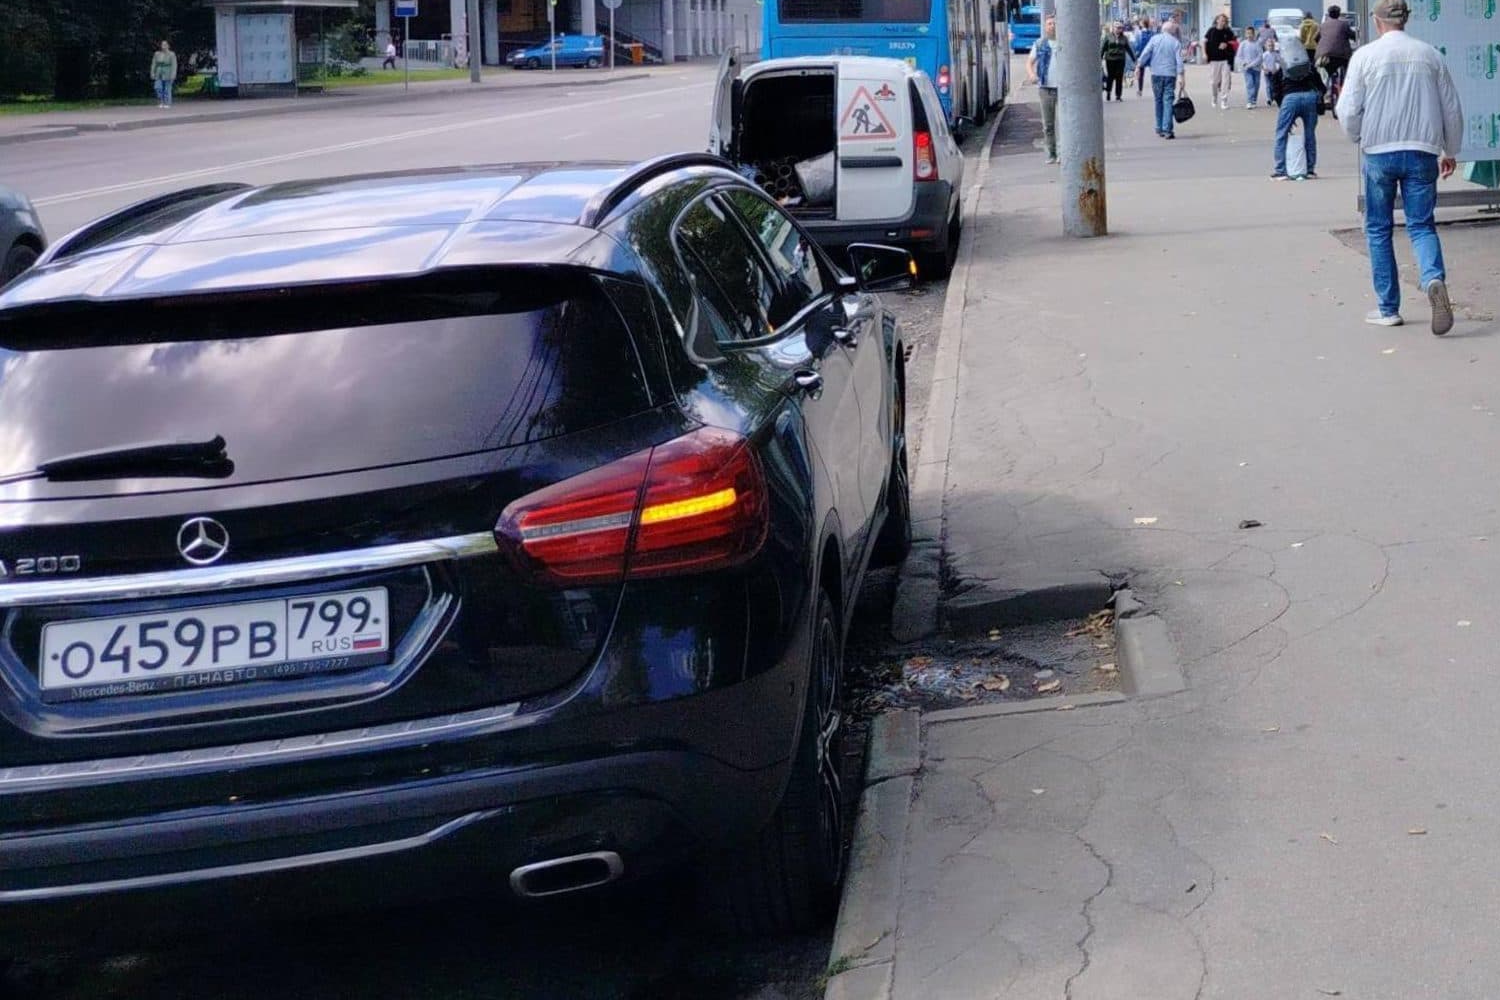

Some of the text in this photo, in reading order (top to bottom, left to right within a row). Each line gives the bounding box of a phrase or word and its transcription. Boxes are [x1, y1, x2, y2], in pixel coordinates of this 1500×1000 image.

[16, 555, 80, 575] 200
[61, 596, 372, 679] О459РВ 799
[312, 636, 351, 654] RUS
[71, 681, 156, 700] Mercedes-Benz
